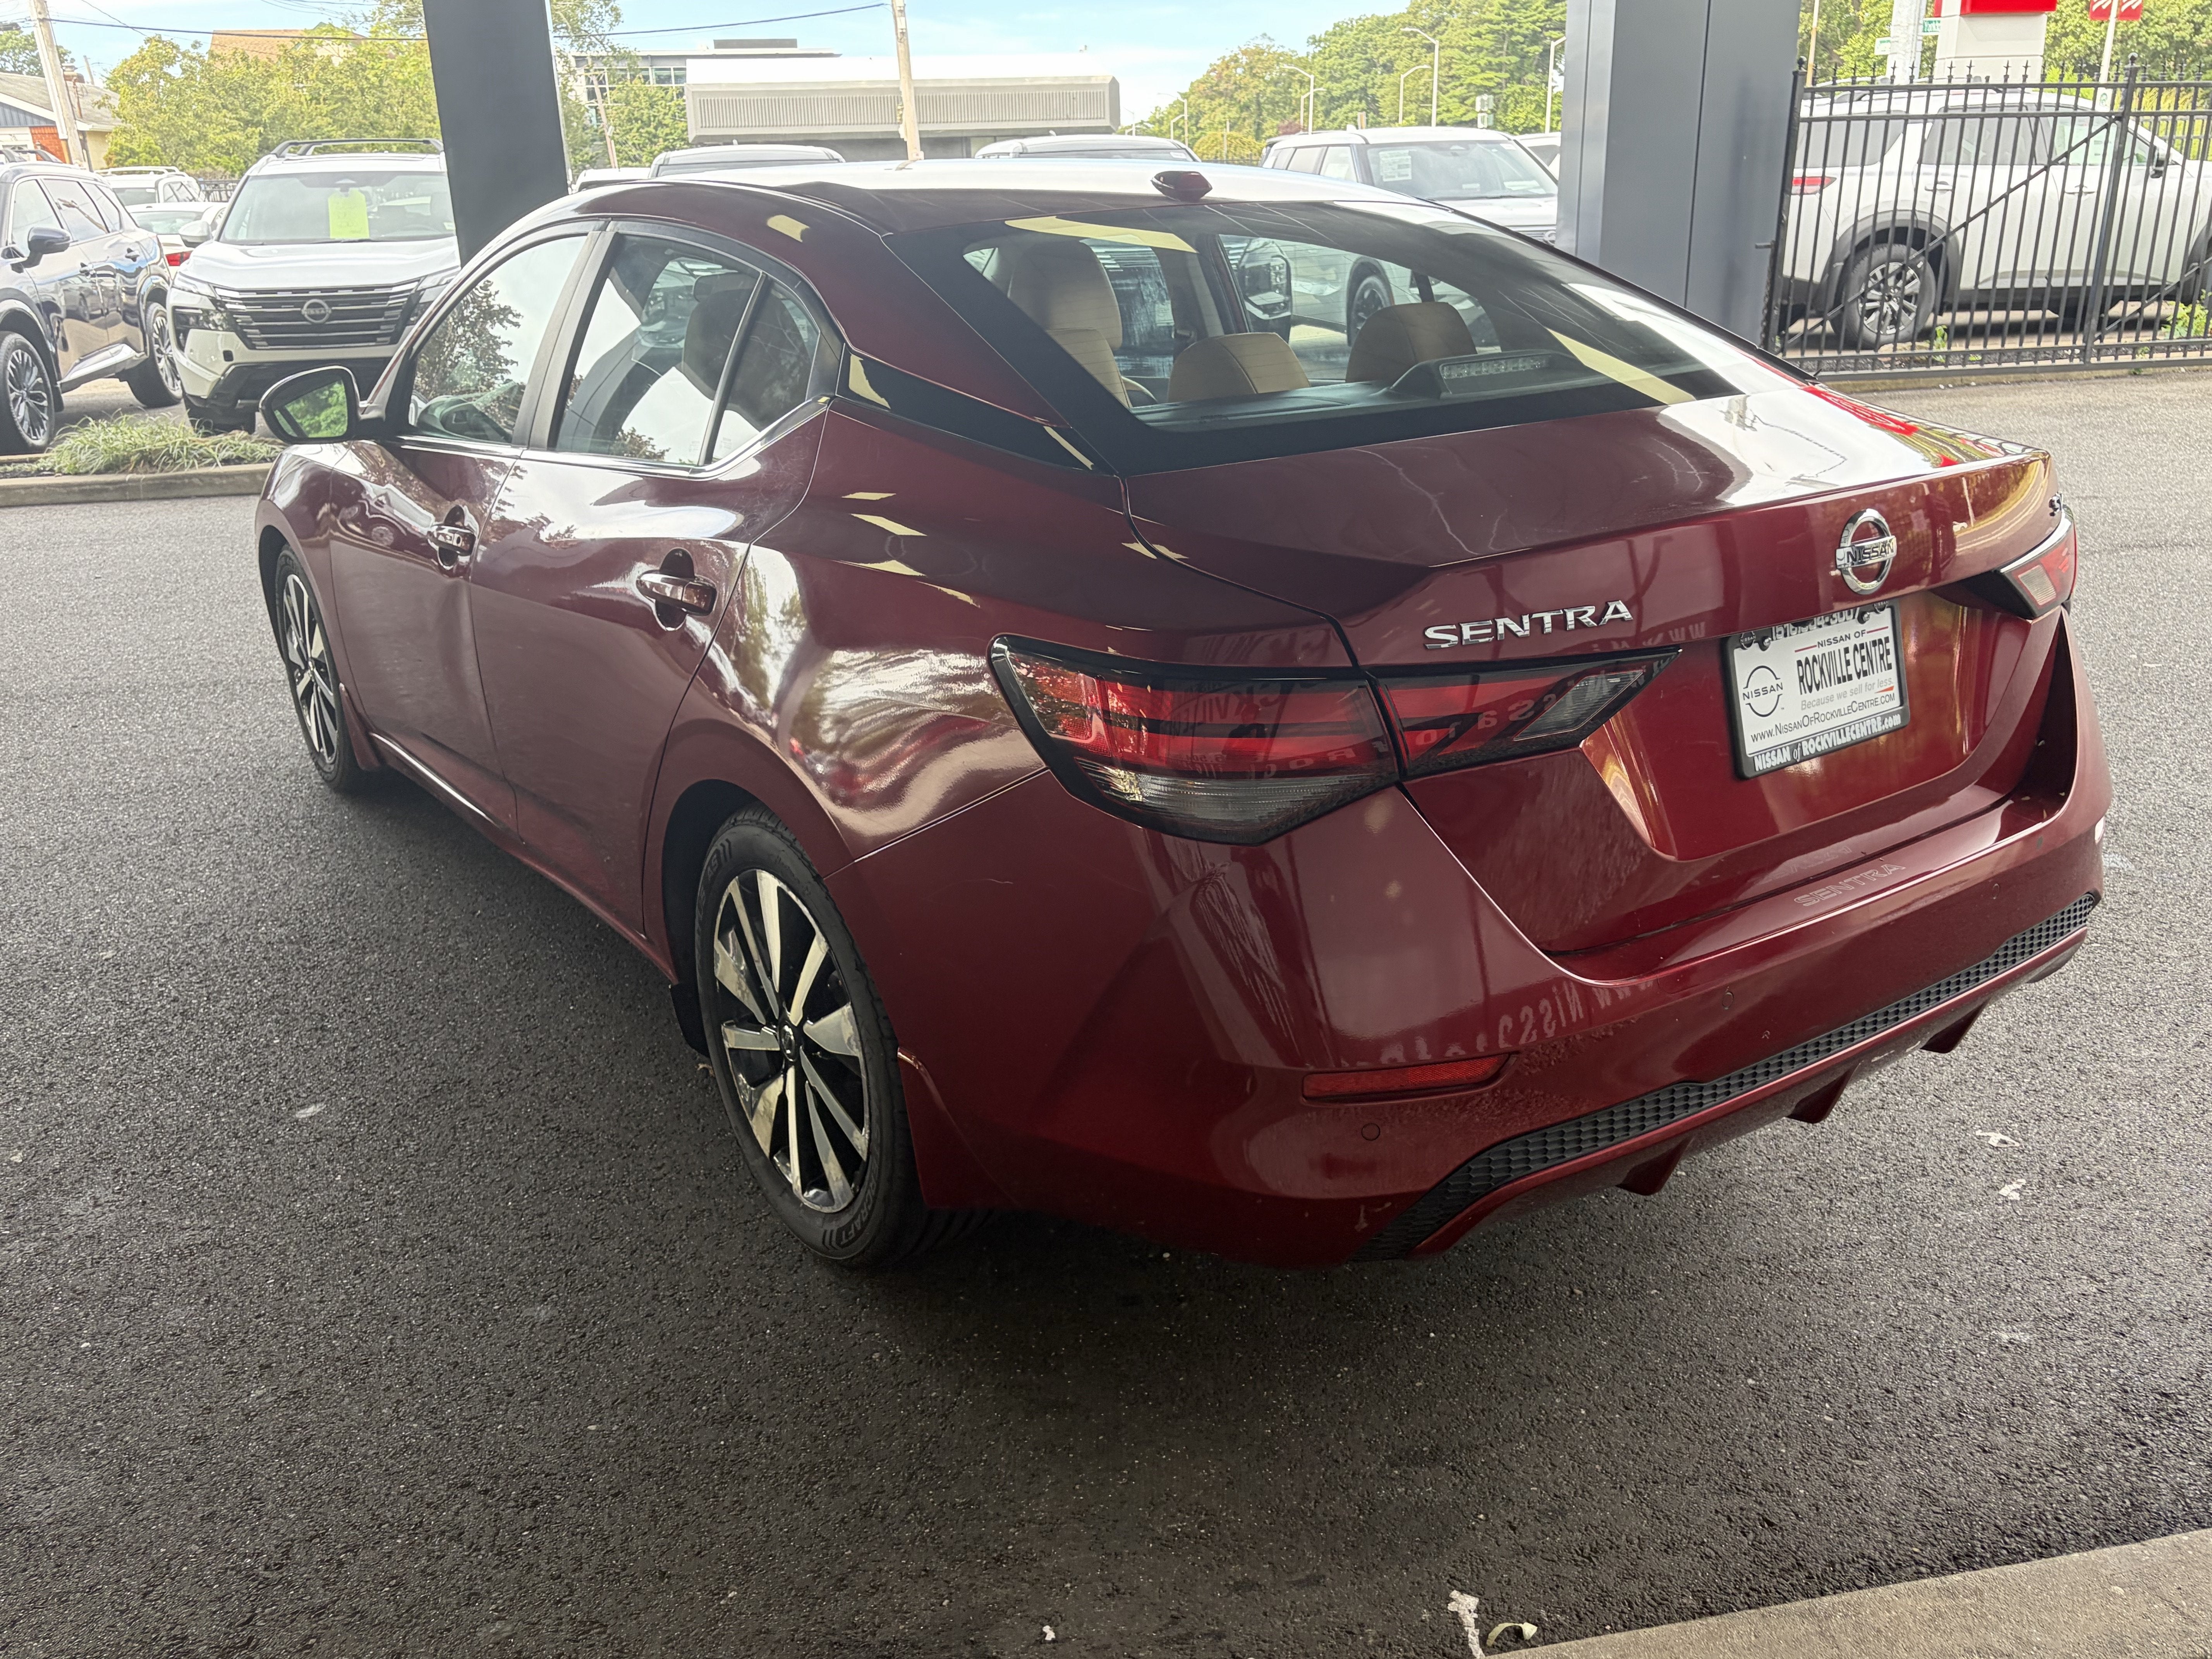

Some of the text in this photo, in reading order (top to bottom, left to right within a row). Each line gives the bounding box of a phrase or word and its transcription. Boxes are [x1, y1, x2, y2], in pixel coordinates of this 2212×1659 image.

[1846, 541, 1894, 563] NISSAN
[1423, 599, 1633, 649] SENTRA
[1817, 629, 1866, 648] NISSAN OF
[1796, 636, 1893, 695] ROCKVILLE CENTRE
[1743, 682, 1783, 701] NISSAN
[1801, 678, 1894, 710] Because we sell for less.
[1754, 714, 1901, 771] NISSAN of ROCKVILLECENTRE.com
[1794, 864, 1906, 907] SENTRA
